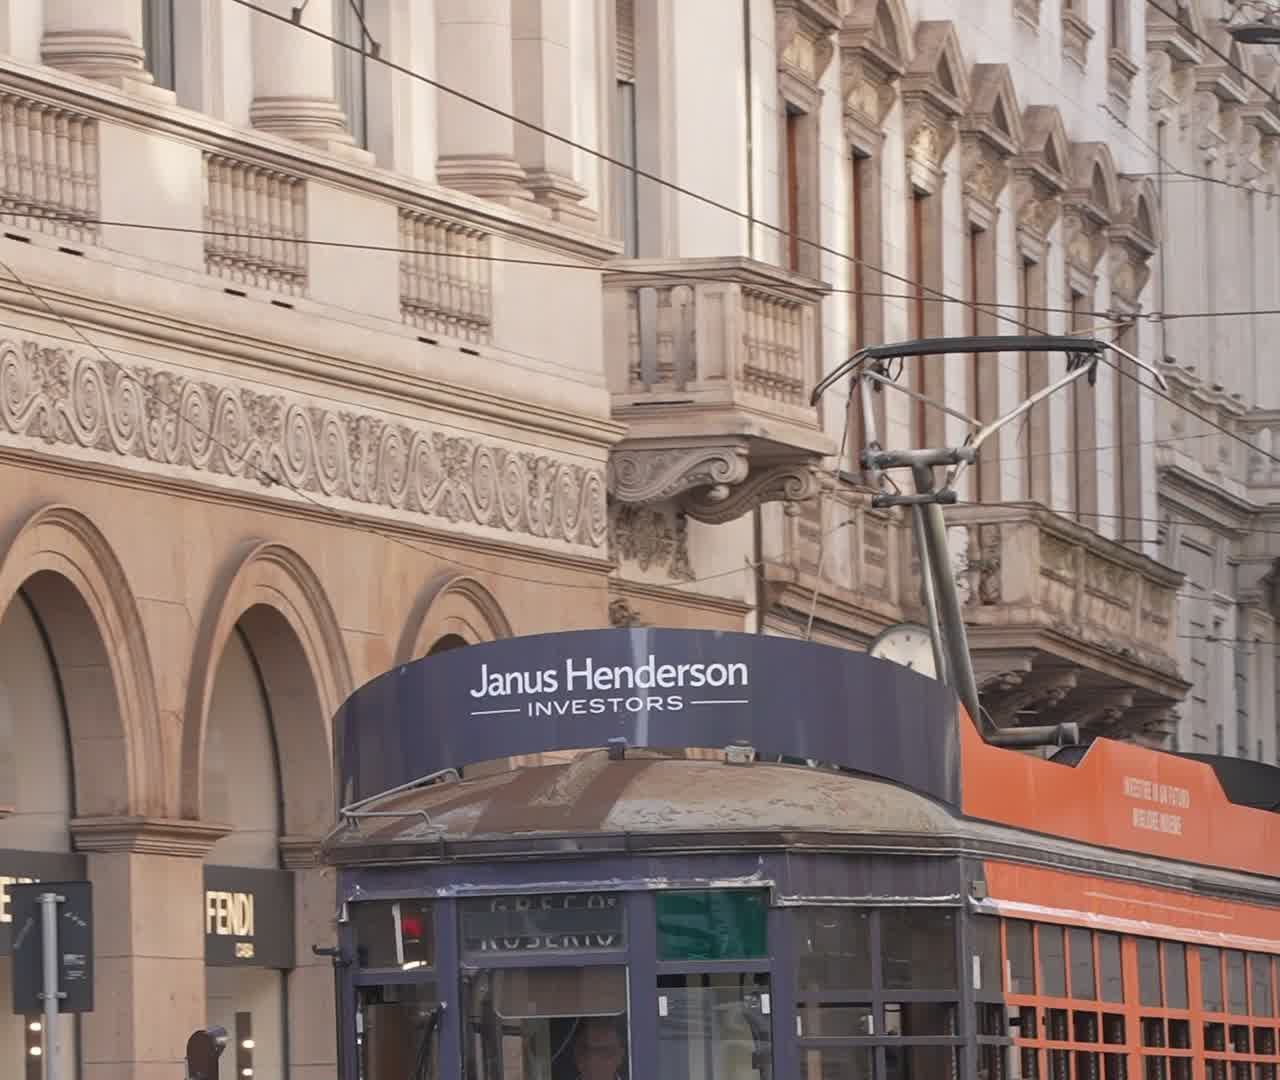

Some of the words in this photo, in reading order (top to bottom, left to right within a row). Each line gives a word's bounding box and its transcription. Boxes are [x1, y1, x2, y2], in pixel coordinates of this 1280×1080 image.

[470, 663, 558, 698] Janus
[566, 654, 749, 691] Henderson
[527, 696, 683, 717] INVESTORS
[206, 890, 254, 937] FENDI
